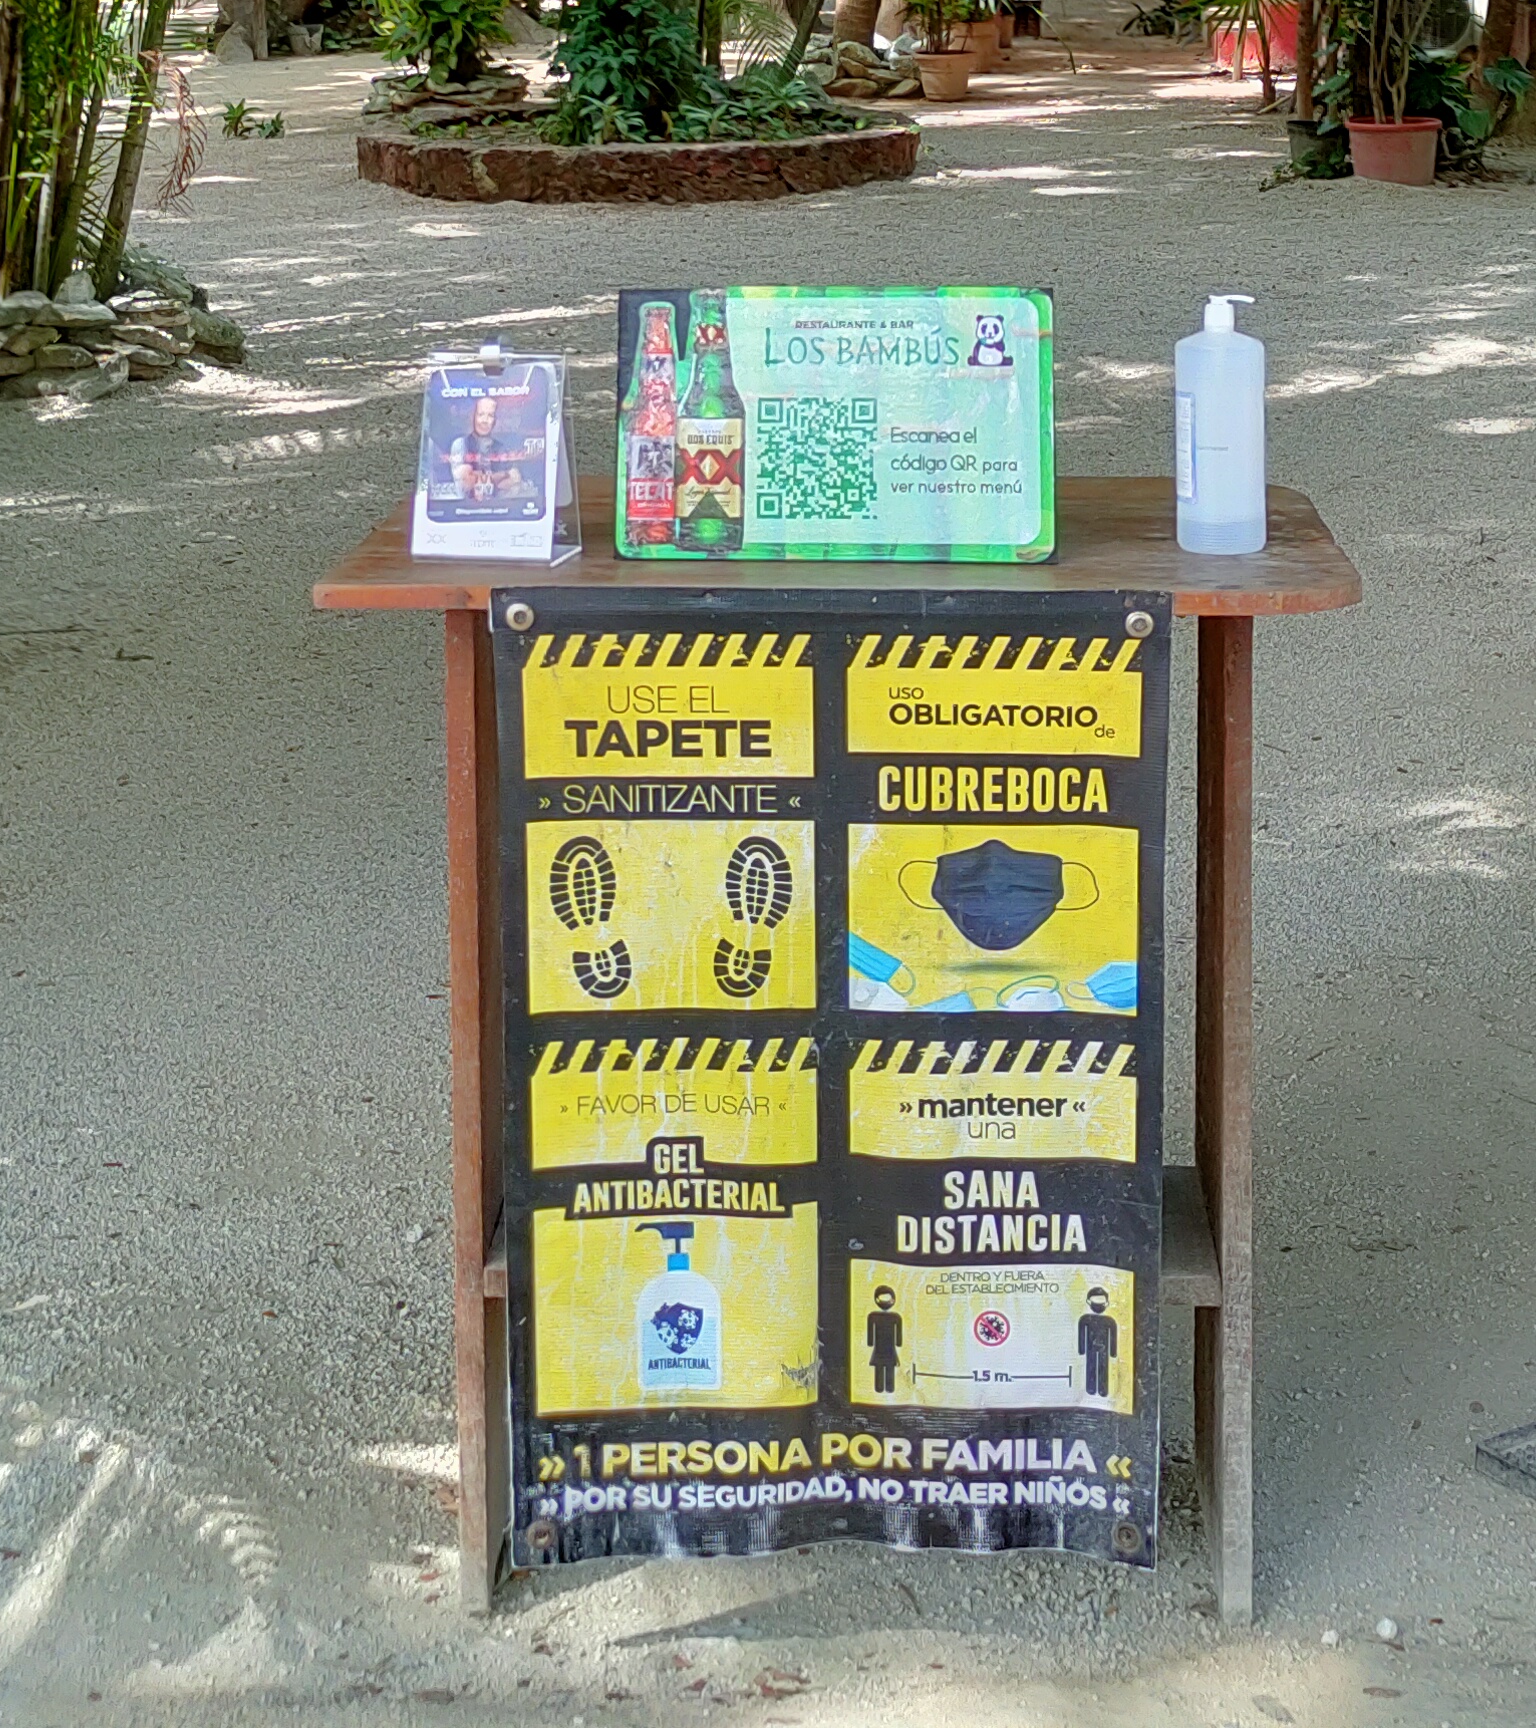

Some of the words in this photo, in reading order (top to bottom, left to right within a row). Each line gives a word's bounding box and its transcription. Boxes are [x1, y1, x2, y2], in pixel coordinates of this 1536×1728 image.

[794, 320, 877, 330] RESTAURANTE
[890, 320, 915, 330] BAR
[470, 387, 487, 397] EL
[890, 426, 960, 444] Escanea
[963, 426, 978, 444] el
[890, 454, 947, 475] código
[950, 454, 979, 472] QR
[982, 459, 1018, 475] para
[890, 483, 913, 495] ver
[918, 480, 977, 495] nuestro
[980, 479, 1022, 495] menú
[606, 684, 678, 715] USE
[689, 684, 730, 714] EL
[888, 702, 1099, 729] OBLIGATORIO
[564, 718, 773, 759] TAPETE
[1094, 722, 1116, 740] de
[562, 783, 778, 815] SANITIZANTE
[878, 765, 1109, 813] CUBREBOCA
[576, 1092, 660, 1117] FAVOR
[665, 1093, 698, 1114] DE
[704, 1093, 771, 1117] USAR
[917, 1092, 1068, 1120] mantener
[967, 1120, 1017, 1140] una
[652, 1142, 702, 1174] GEL
[573, 1179, 786, 1214] ANTIBACTERIAL
[943, 1170, 1040, 1210] SANA
[897, 1214, 1087, 1255] DISTANCIA
[925, 1284, 951, 1295] DEL
[951, 1282, 1060, 1294] ESTABLECIMIENTO
[940, 1271, 991, 1283] DENTRO
[993, 1271, 1002, 1282] Y
[1004, 1270, 1045, 1282] FUERA
[647, 1357, 712, 1371] ANTIBACTERIAL
[972, 1369, 991, 1383] 1.5
[574, 1444, 591, 1478] 1
[601, 1437, 813, 1477] PERSONA
[820, 1432, 913, 1469] POR
[921, 1437, 1098, 1473] FAMILIA
[565, 1485, 627, 1515] POR
[632, 1484, 673, 1510] SU
[677, 1475, 854, 1510] SEGURIDAD,
[858, 1477, 904, 1502] NO
[909, 1479, 1008, 1505] TRAER
[1014, 1475, 1108, 1511] NIÑOS
